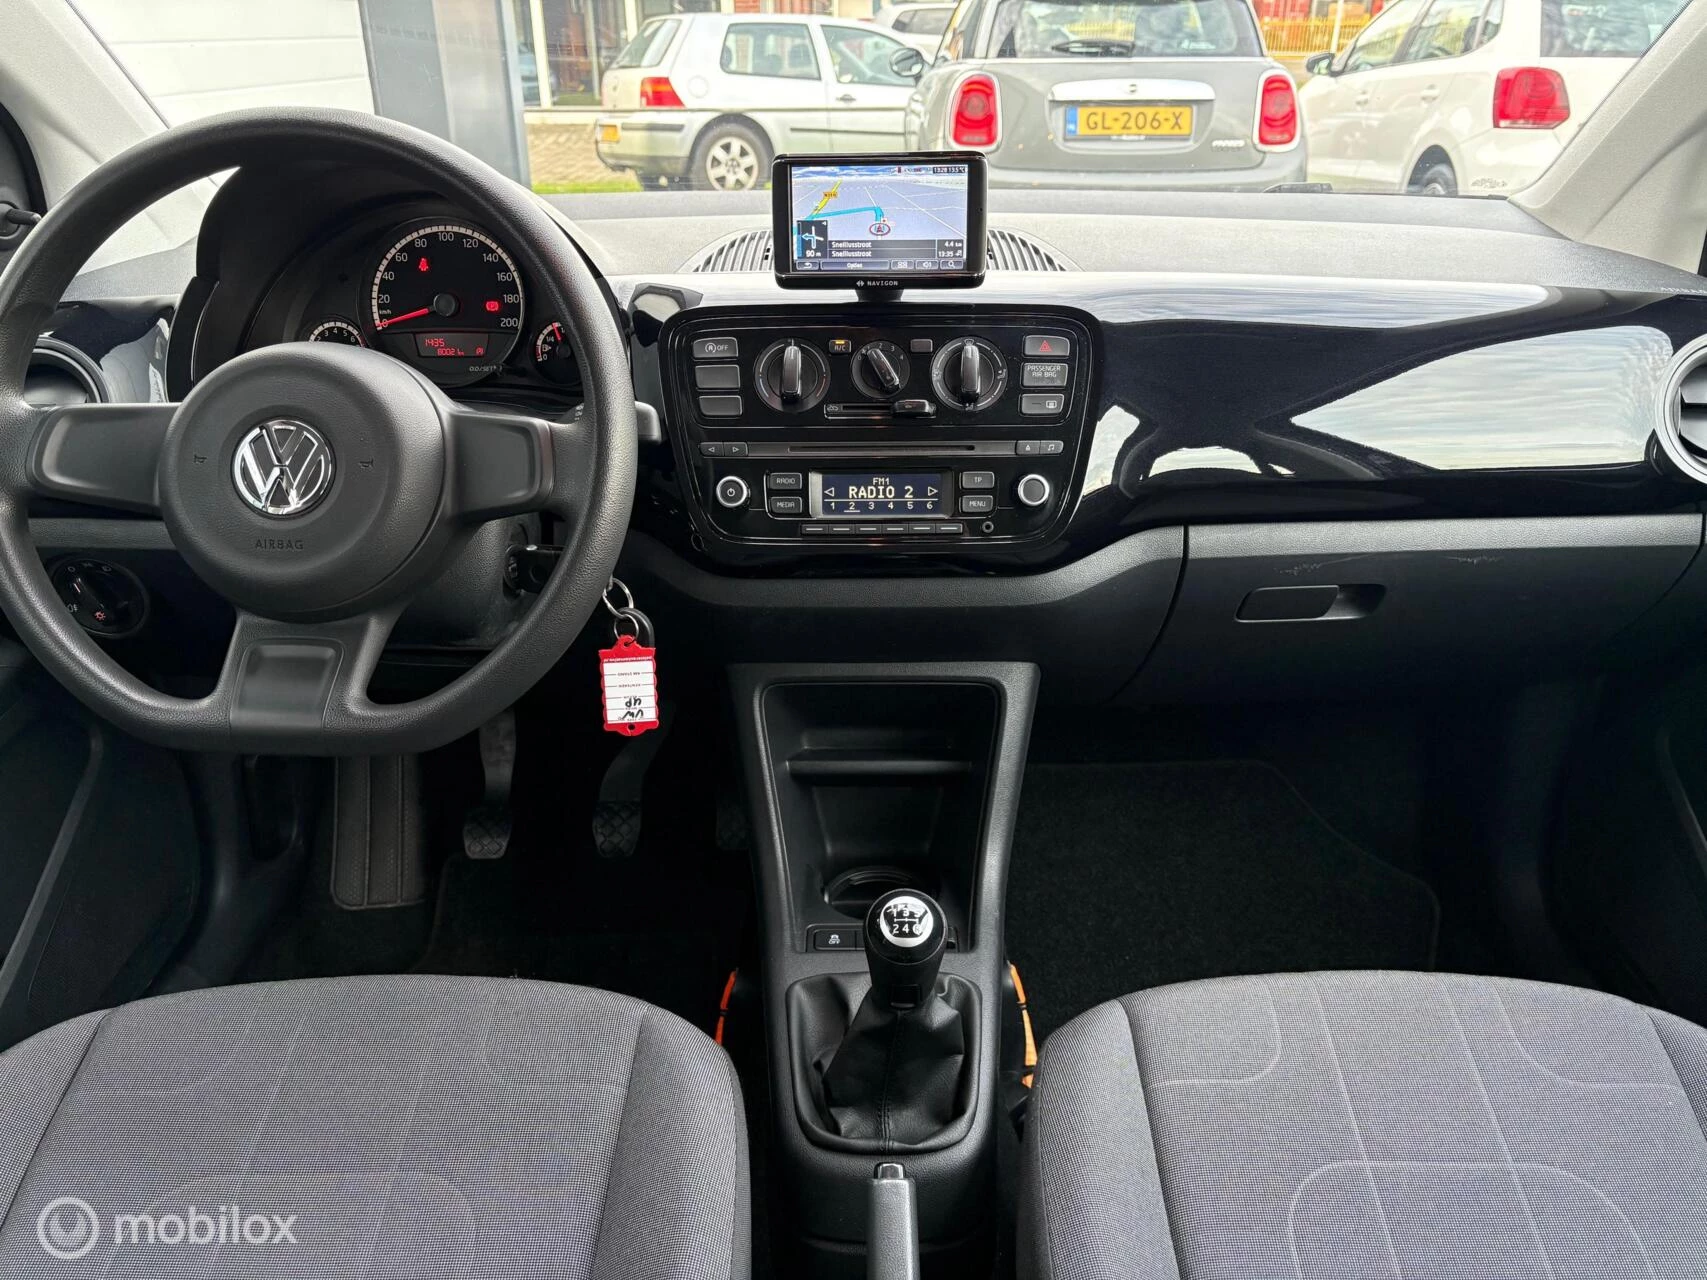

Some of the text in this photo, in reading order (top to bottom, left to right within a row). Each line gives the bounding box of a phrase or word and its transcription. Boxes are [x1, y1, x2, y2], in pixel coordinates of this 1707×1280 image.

[1086, 111, 1183, 130] GL-206-X
[437, 232, 454, 242] 100
[414, 238, 428, 248] 80
[463, 238, 479, 248] 120
[395, 252, 408, 262] 60
[483, 253, 499, 263] 140
[382, 271, 395, 281] 40
[497, 272, 513, 281] 160
[379, 294, 391, 304] 20
[503, 294, 520, 304] 180
[500, 318, 518, 328] 200
[543, 353, 548, 361] 0
[872, 477, 890, 486] FM1
[848, 485, 914, 499] RADIO 2
[830, 501, 933, 510] 1 2 3 4 5 6
[254, 539, 304, 550] AIRBAG
[892, 923, 900, 934] 2
[902, 923, 910, 934] 4
